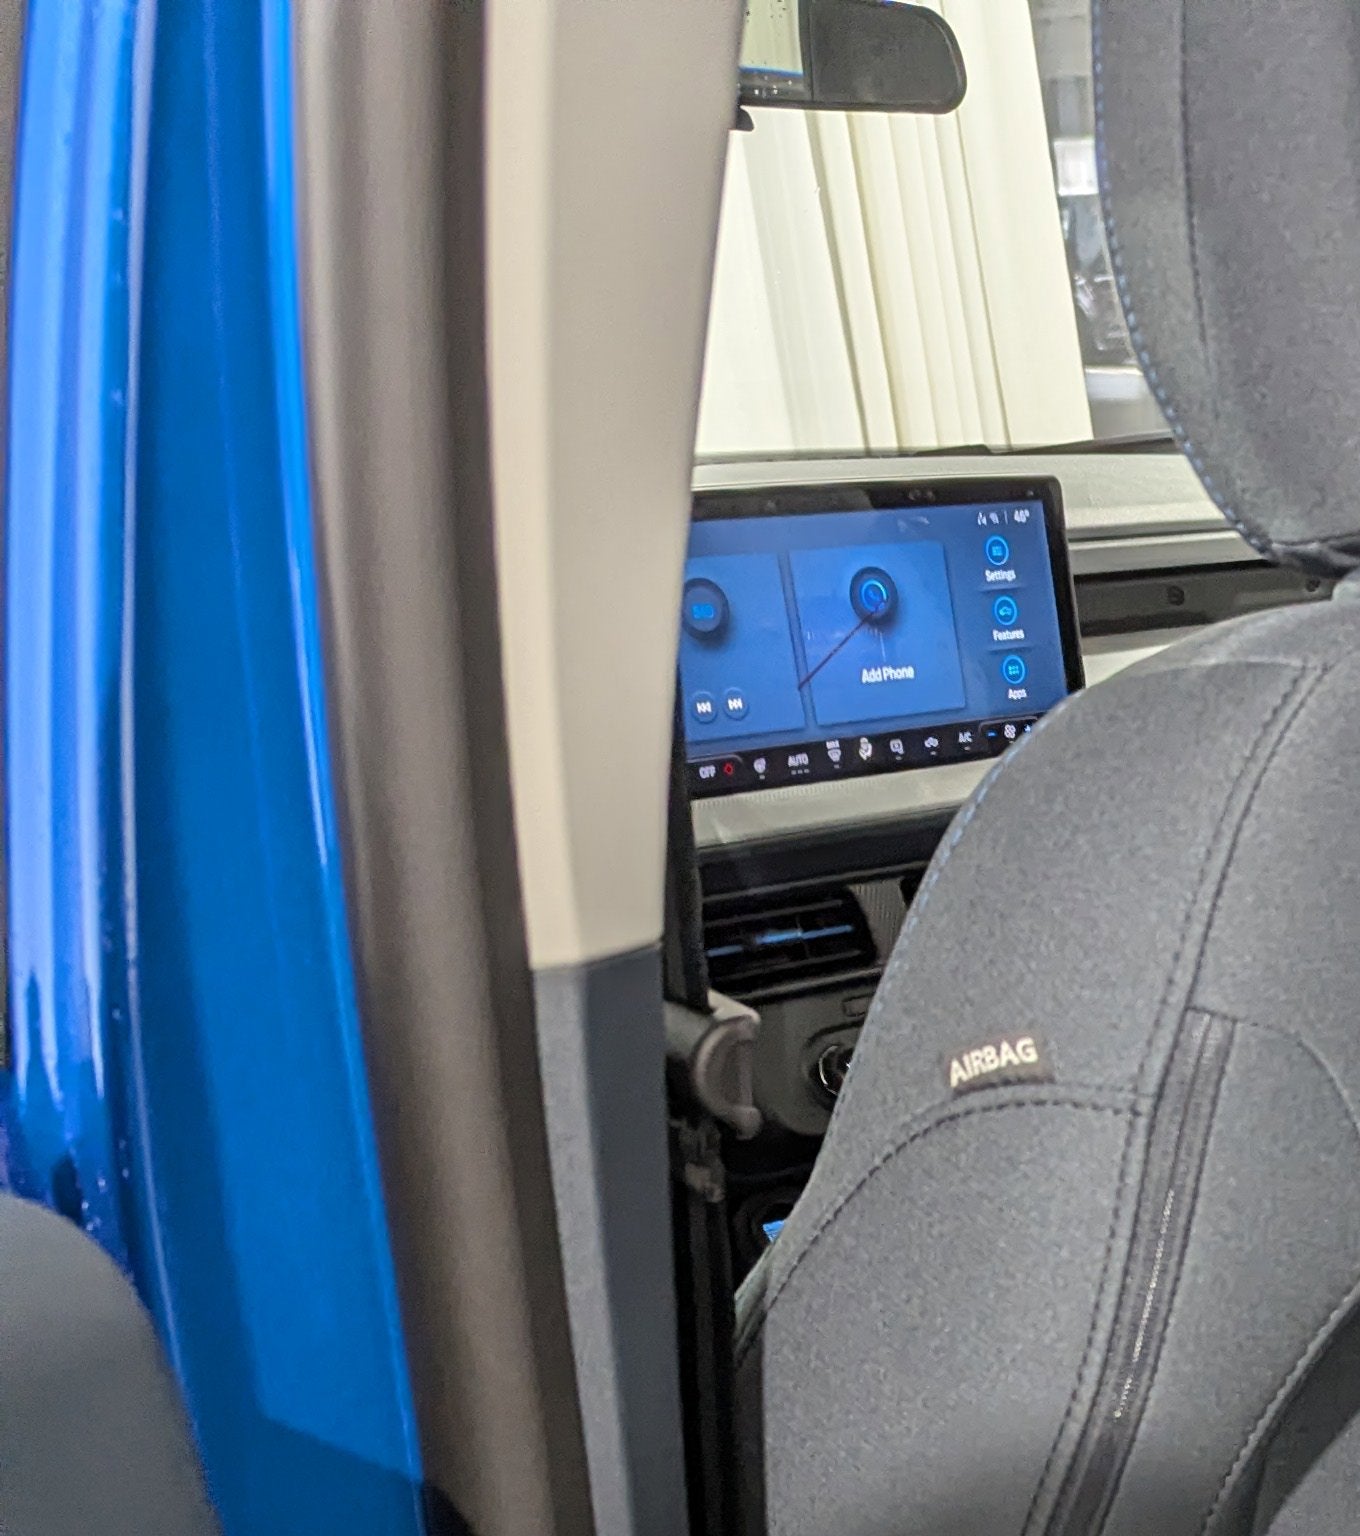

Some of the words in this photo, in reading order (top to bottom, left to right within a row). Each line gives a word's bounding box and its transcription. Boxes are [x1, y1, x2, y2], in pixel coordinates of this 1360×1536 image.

[985, 569, 1016, 582] Settings
[993, 629, 1024, 641] Features
[862, 668, 882, 684] Add
[882, 666, 915, 681] Phone
[1008, 688, 1027, 700] Apps
[699, 765, 716, 779] OFF
[786, 753, 809, 768] AUTO
[950, 1037, 1039, 1088] AIRBAG
